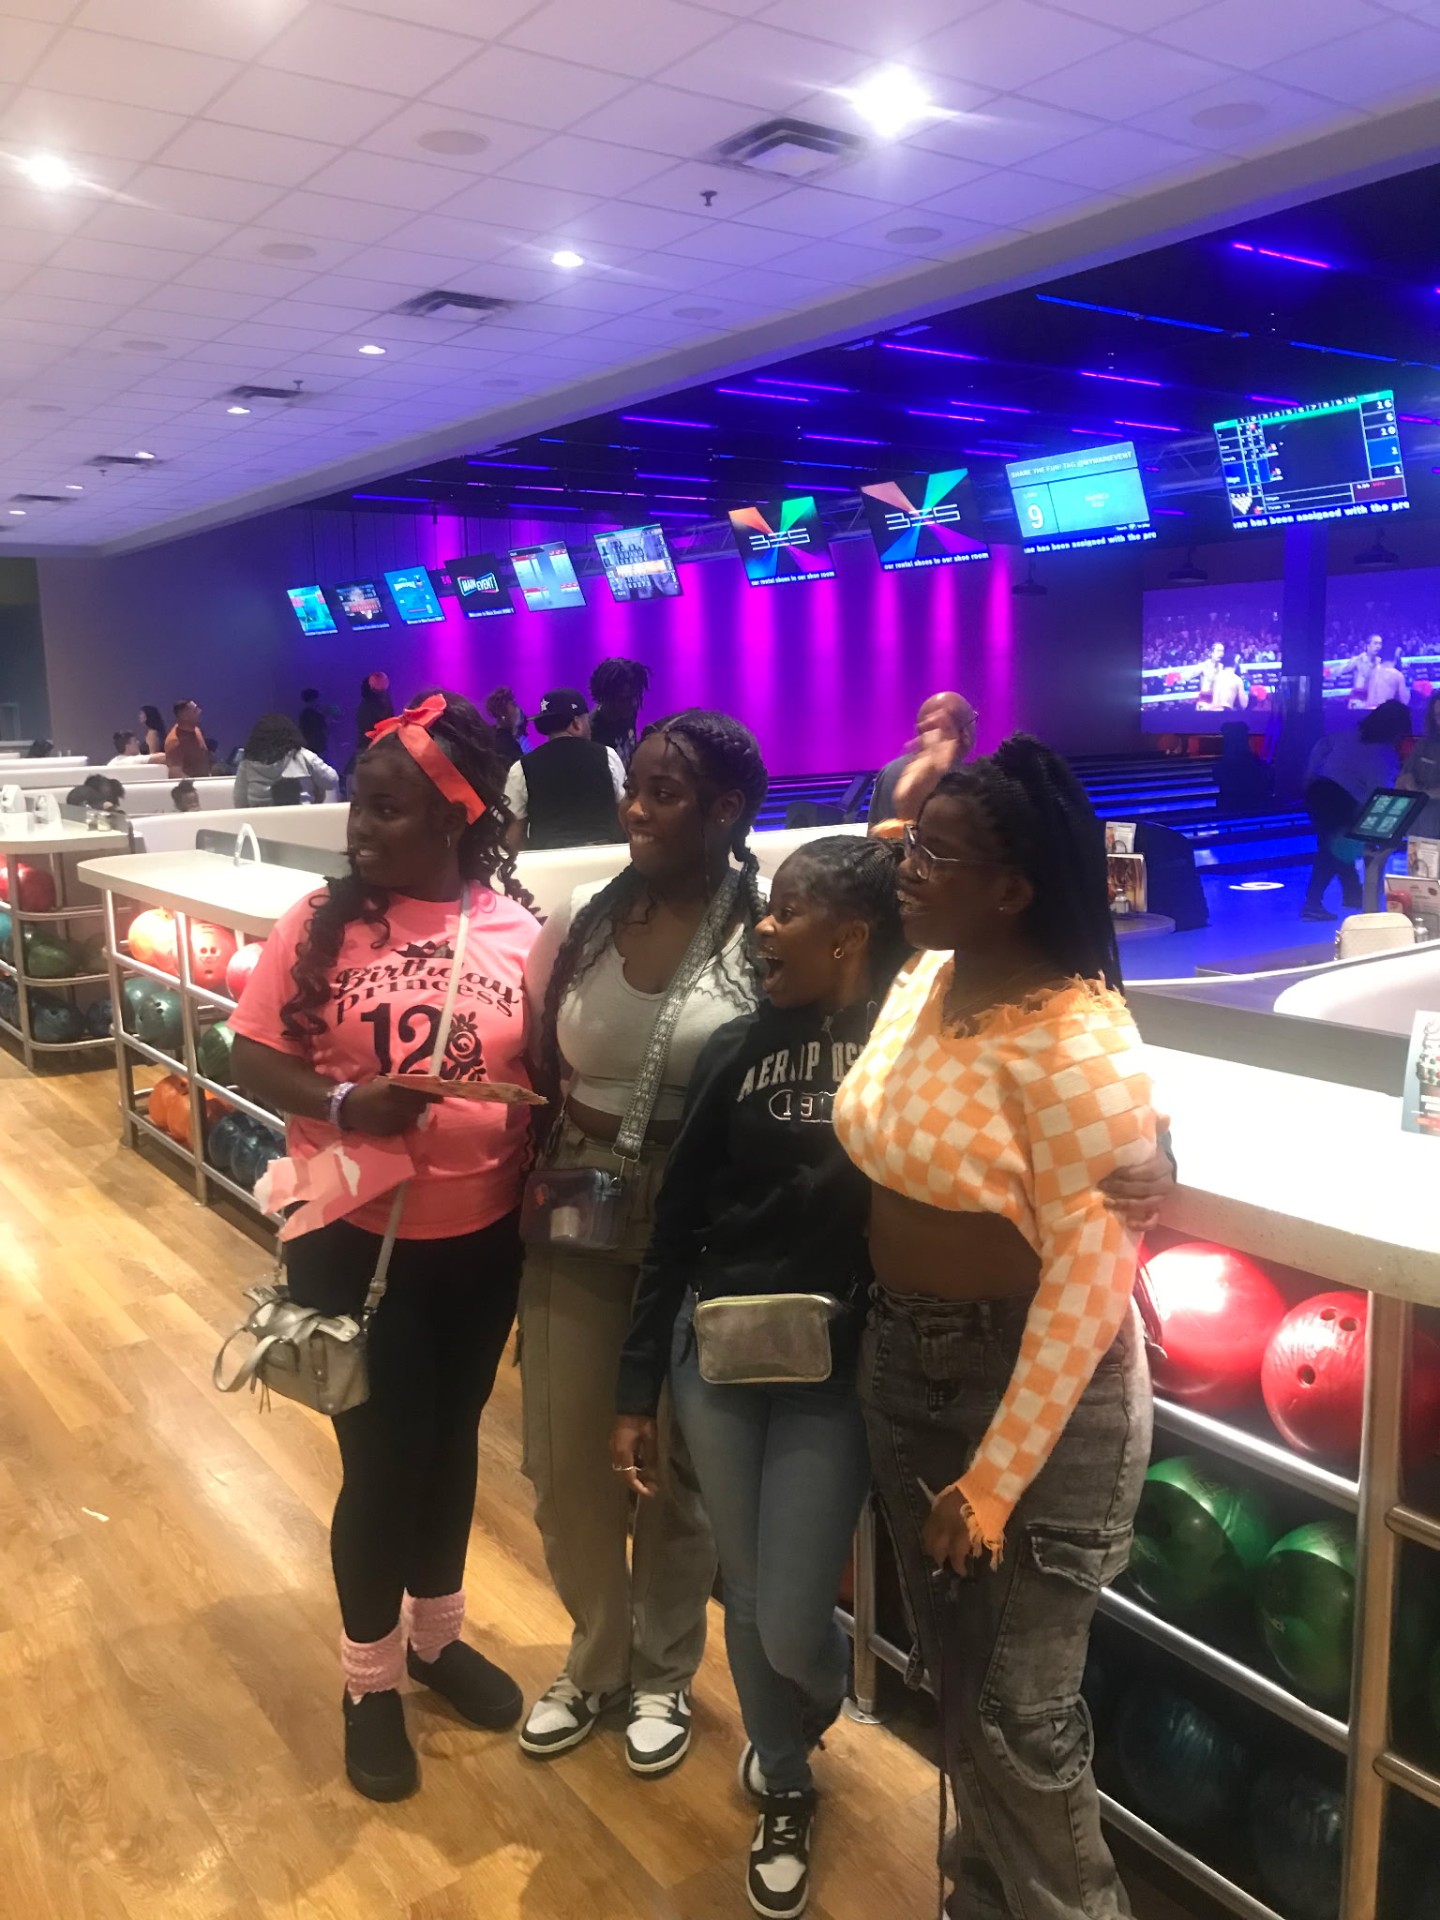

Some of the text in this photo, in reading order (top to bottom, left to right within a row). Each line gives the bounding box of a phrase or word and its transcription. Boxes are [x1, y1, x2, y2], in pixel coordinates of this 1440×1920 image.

[1377, 399, 1392, 410] 16
[1386, 412, 1394, 421] 6
[1381, 426, 1396, 436] 10
[1391, 446, 1399, 455] 1
[1033, 466, 1045, 474] THE
[1394, 465, 1402, 474] 1
[1028, 504, 1044, 529] 9
[1250, 518, 1268, 527] has
[1269, 516, 1294, 525] been
[1296, 508, 1342, 522] assigned
[1344, 504, 1368, 516] with
[1370, 502, 1389, 513] the
[1036, 544, 1050, 552] has
[1051, 542, 1070, 550] been
[1071, 537, 1106, 548] assigned
[1107, 534, 1125, 543] with
[1127, 532, 1141, 541] the
[461, 578, 477, 592] MAIN
[476, 576, 495, 591] EVENT
[361, 1002, 443, 1076] 12
